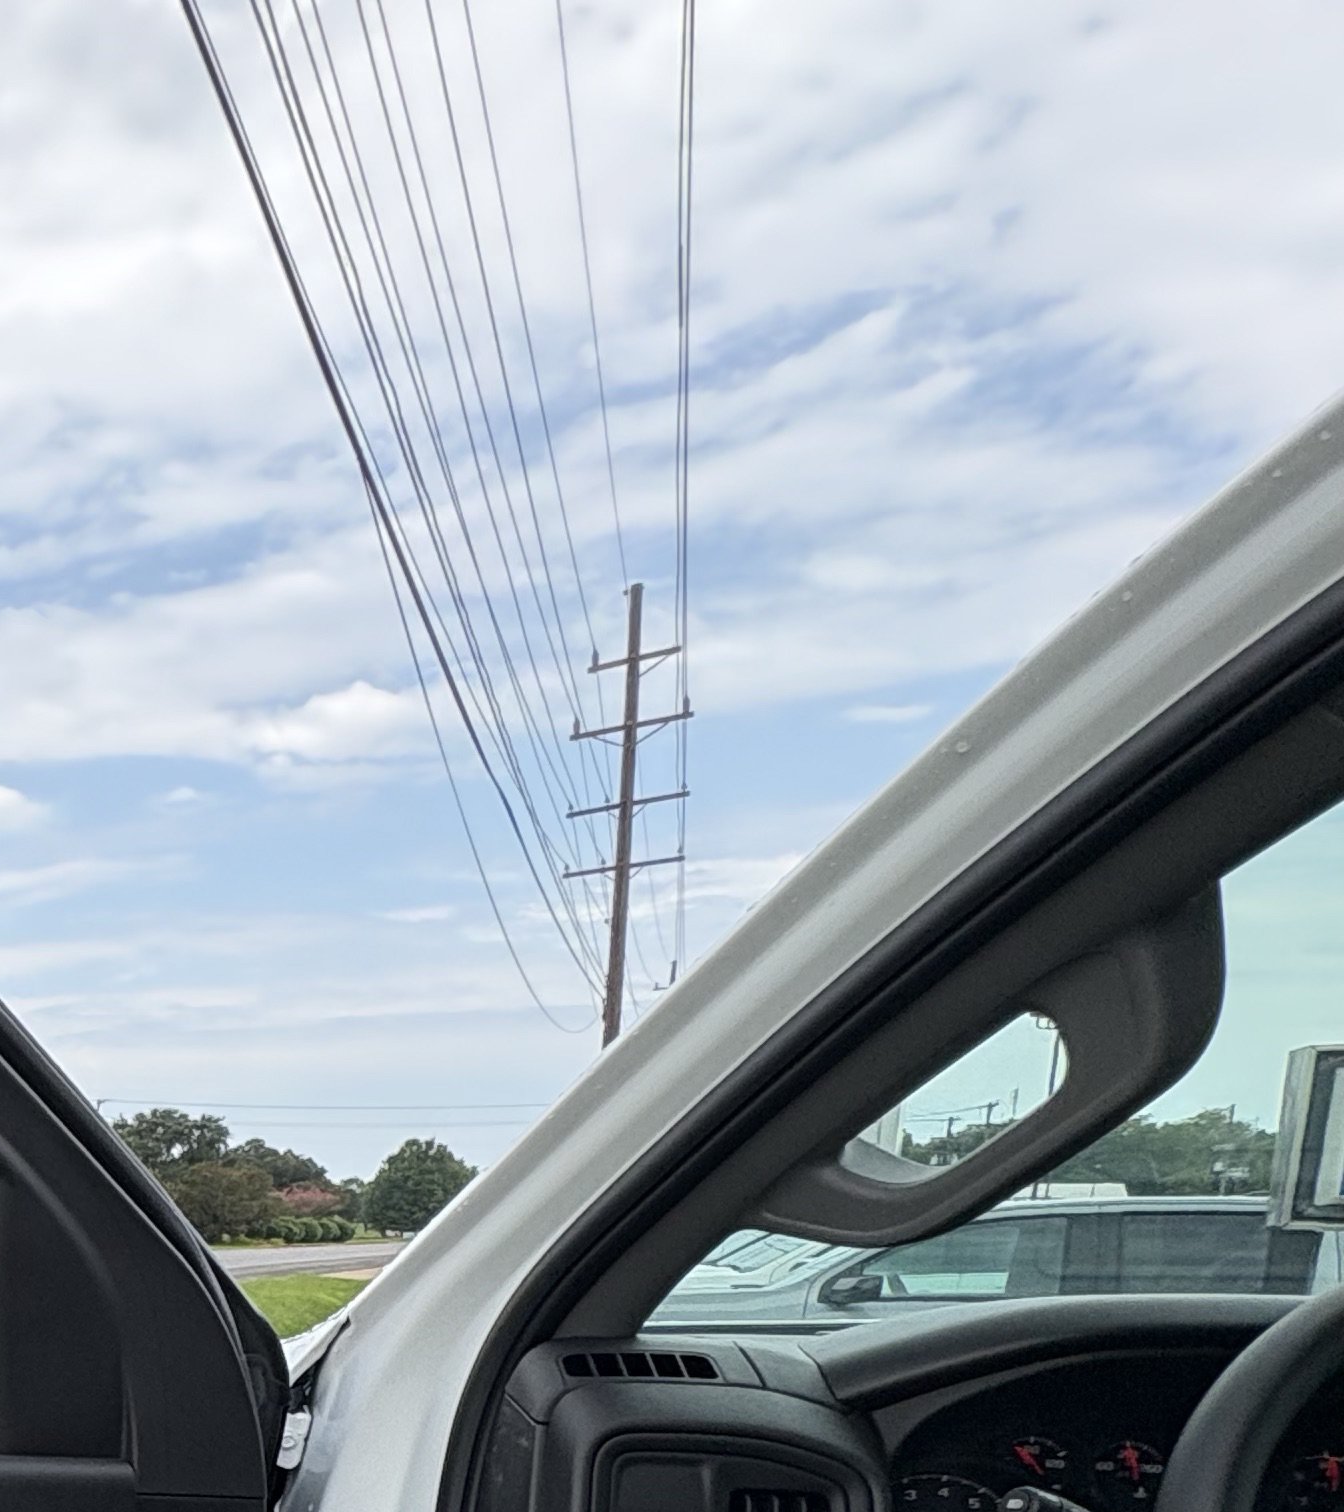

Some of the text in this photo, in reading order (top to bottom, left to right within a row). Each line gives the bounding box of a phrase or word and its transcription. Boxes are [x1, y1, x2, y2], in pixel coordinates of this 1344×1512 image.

[904, 1490, 917, 1501] 3
[937, 1487, 949, 1498] 4
[968, 1498, 981, 1510] 5
